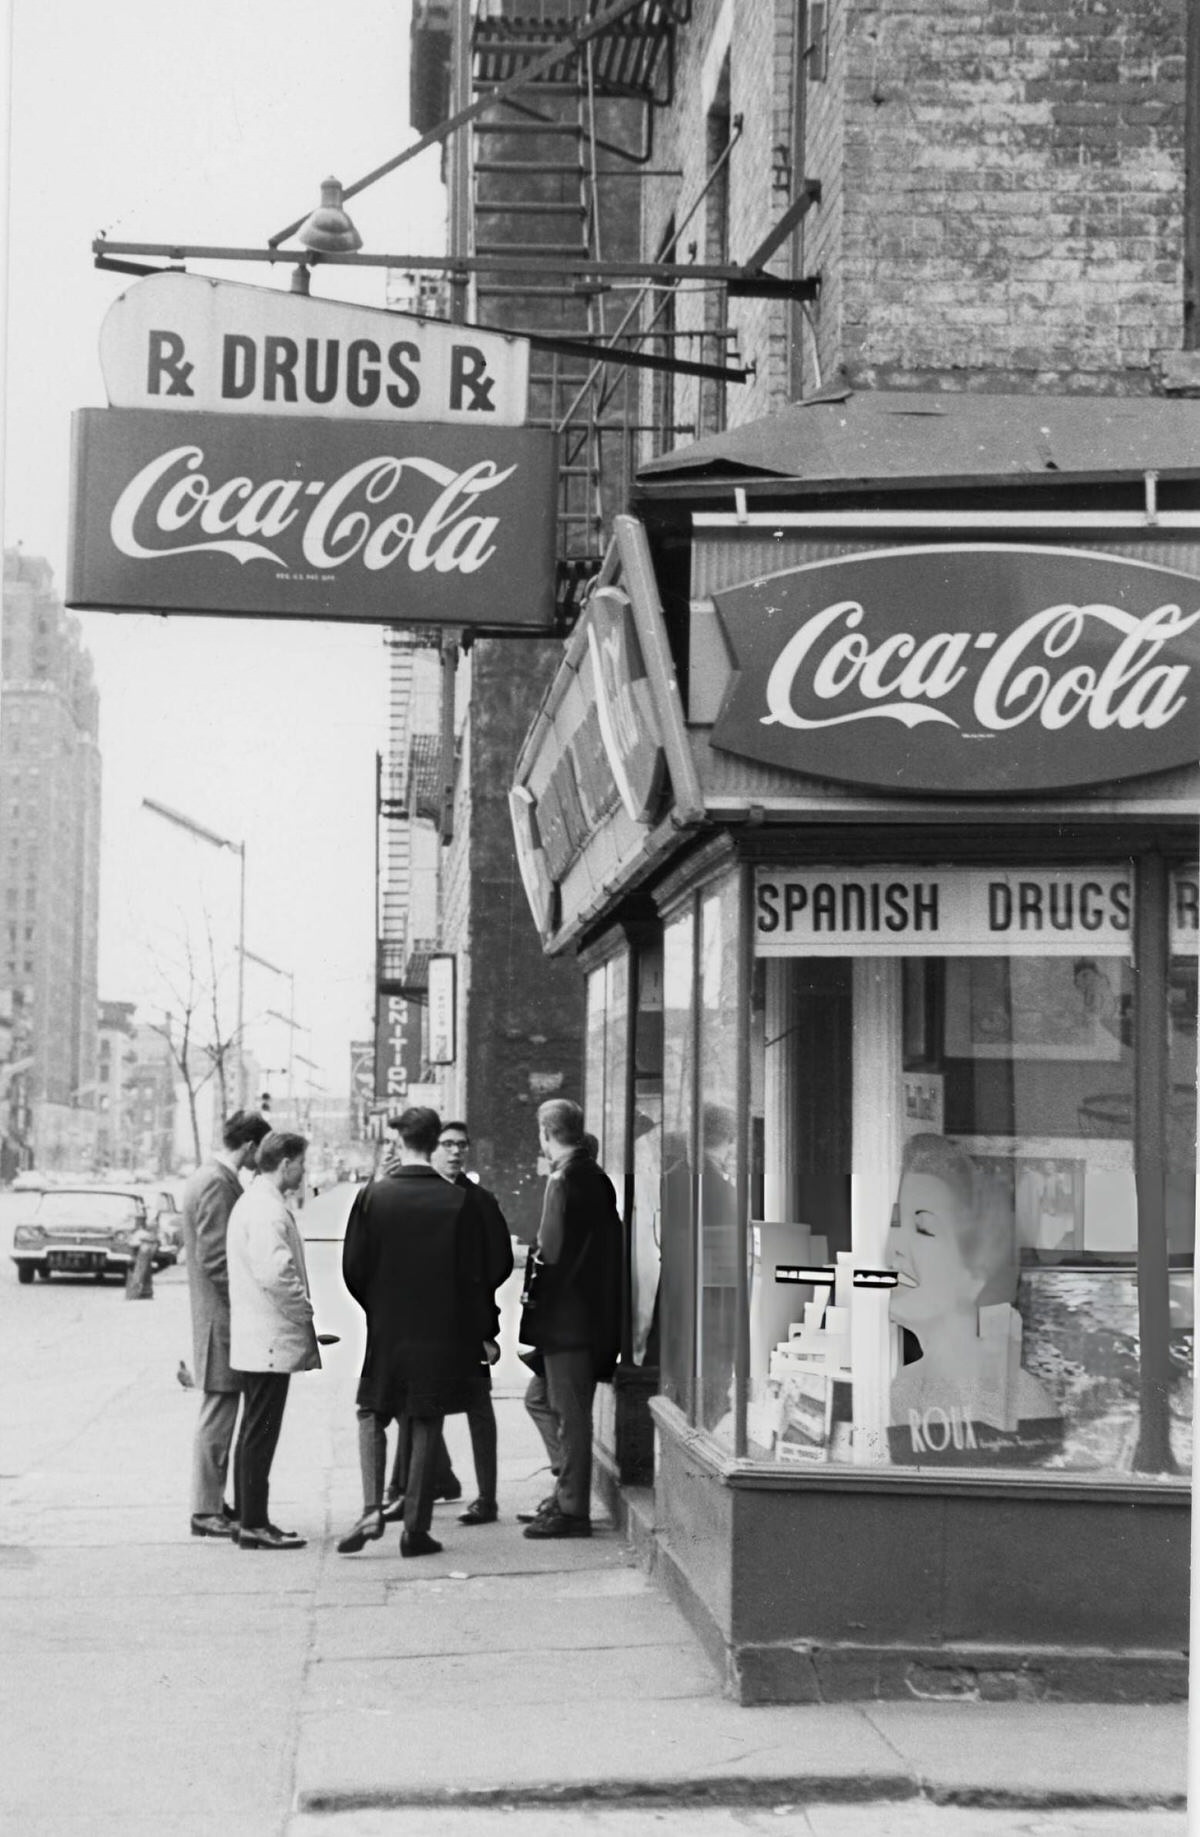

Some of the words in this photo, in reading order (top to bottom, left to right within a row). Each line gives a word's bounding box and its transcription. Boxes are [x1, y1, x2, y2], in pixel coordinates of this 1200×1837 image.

[222, 334, 421, 408] DRUGS
[110, 446, 518, 573] Coca-Cola
[759, 601, 1200, 730] Coca-Cola
[757, 883, 939, 932] SPANISH
[988, 882, 1132, 931] DRUGS
